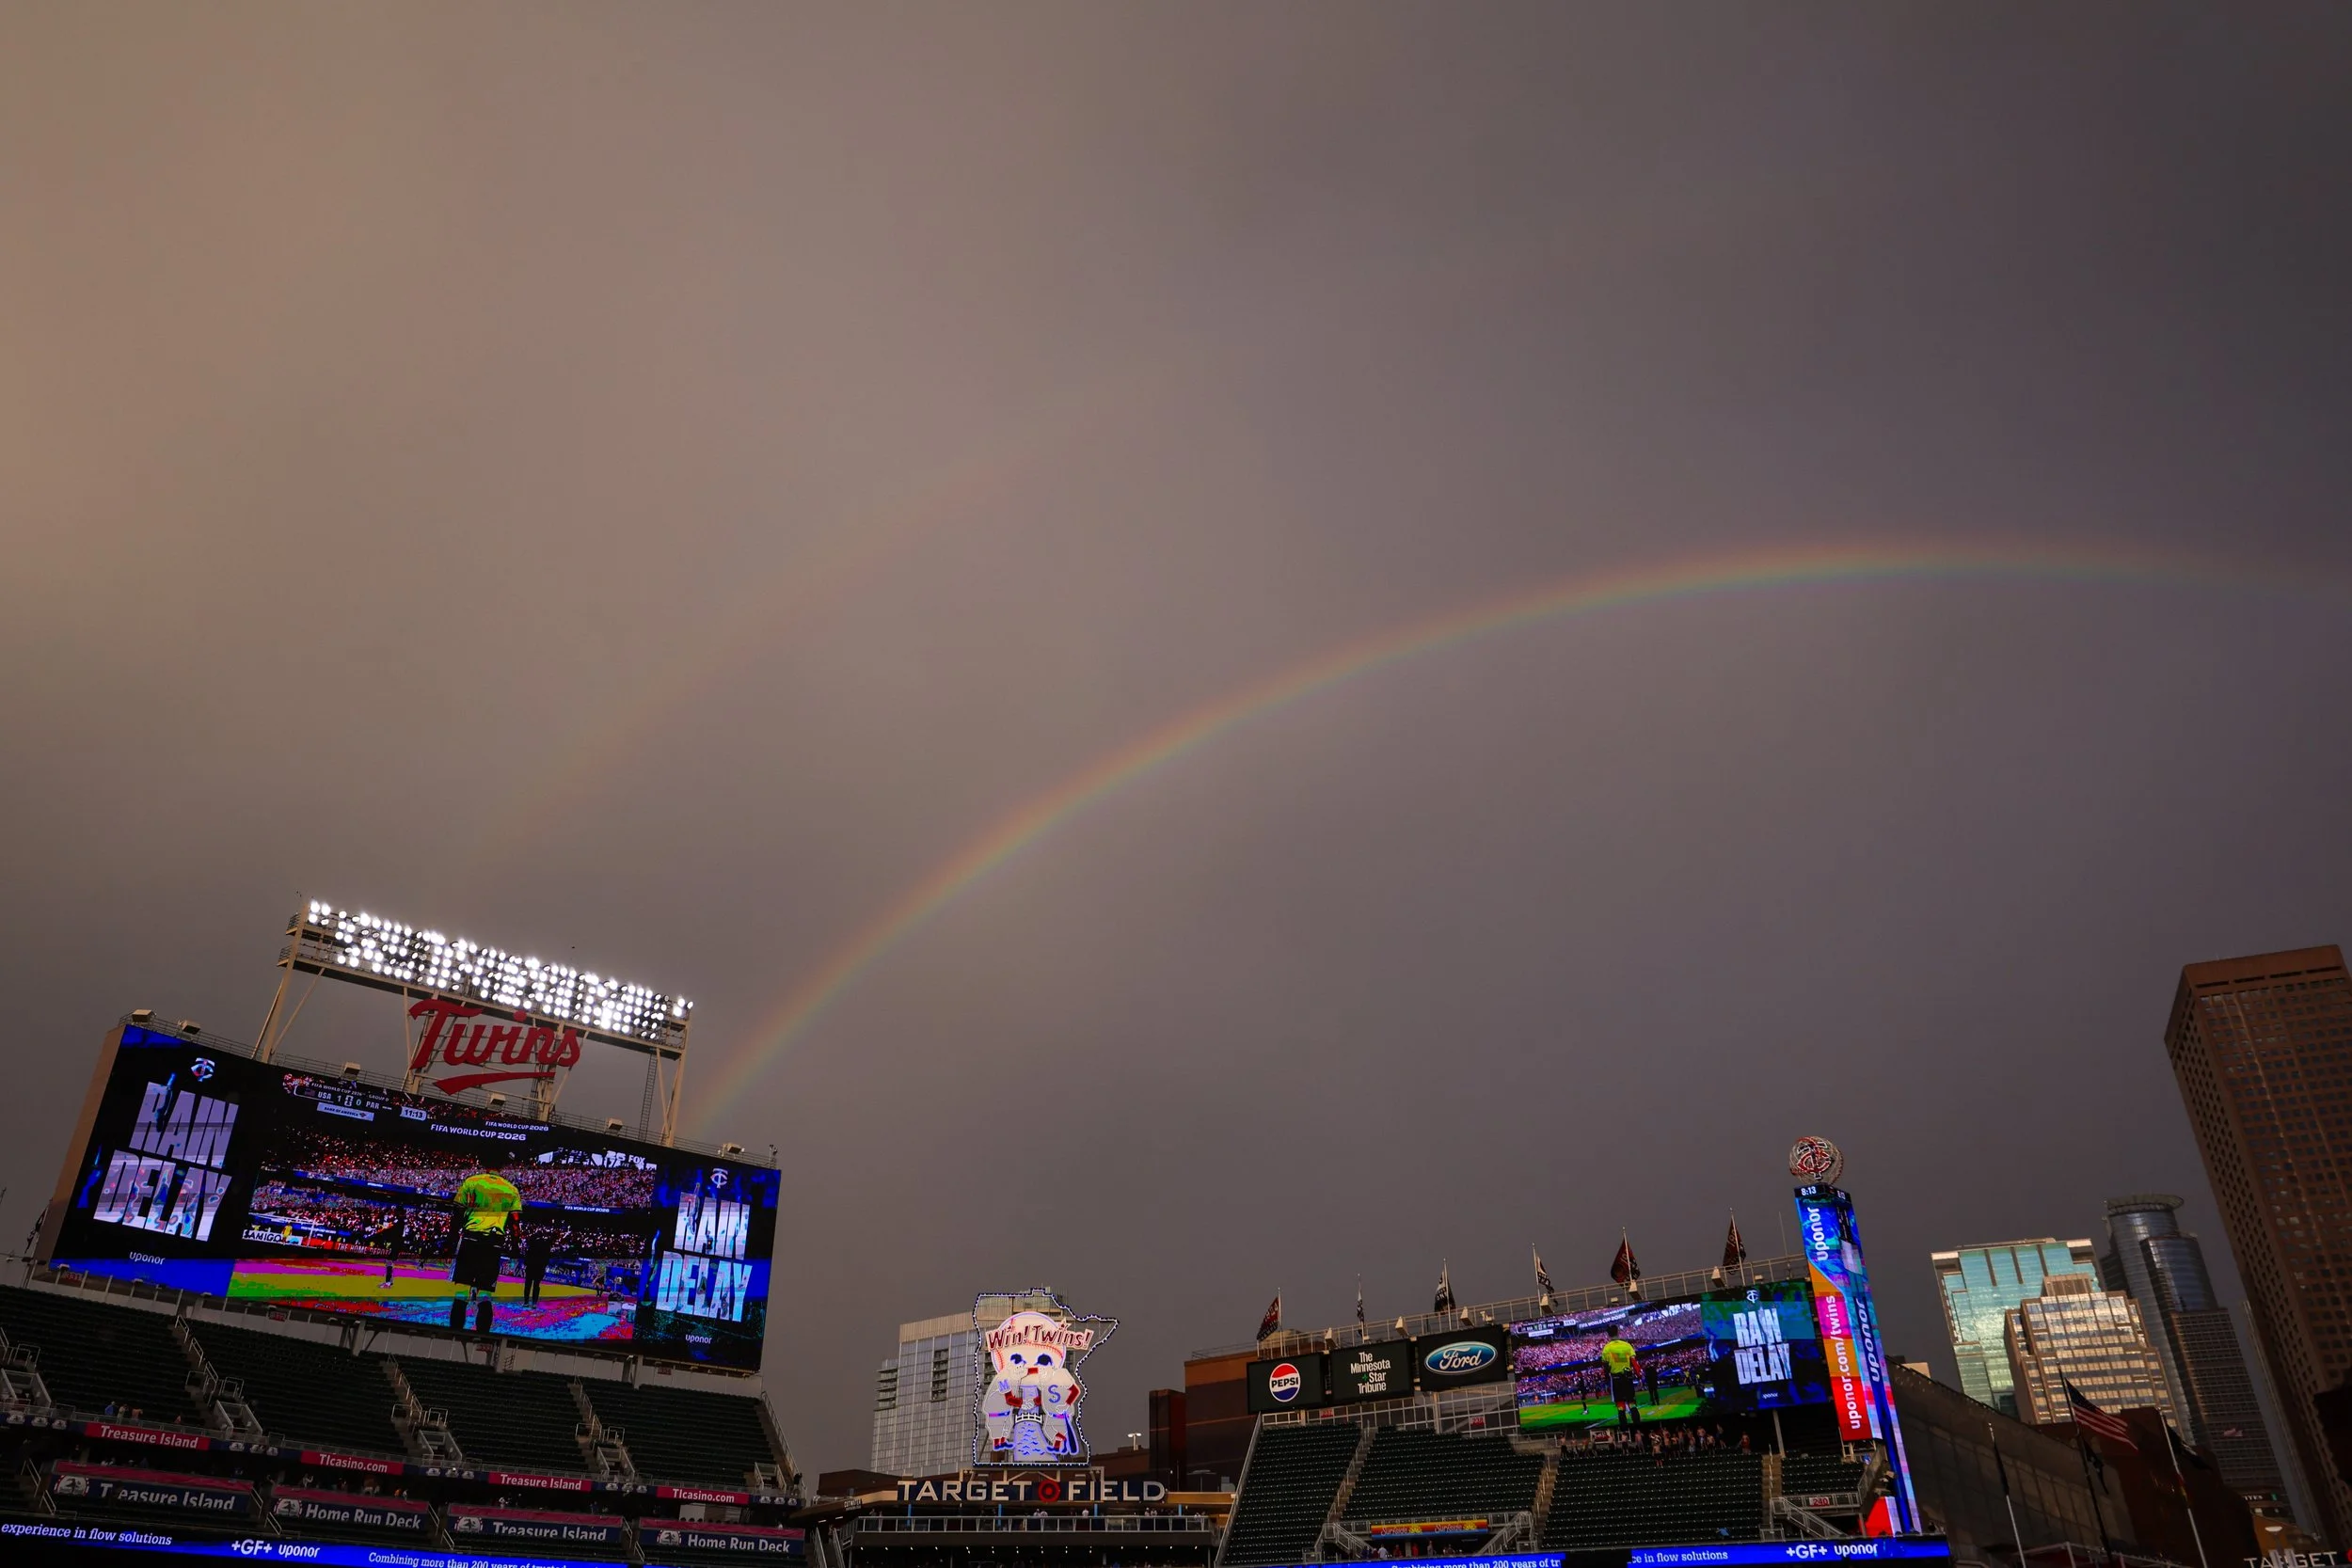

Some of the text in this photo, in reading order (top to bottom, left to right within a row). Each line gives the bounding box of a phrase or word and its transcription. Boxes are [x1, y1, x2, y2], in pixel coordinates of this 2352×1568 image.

[409, 999, 580, 1069] Twins
[318, 1091, 331, 1100] USA
[366, 1101, 380, 1109] PAR
[404, 1109, 423, 1118] 11:13
[129, 1082, 239, 1169] RAIN
[430, 1124, 526, 1141] FIFA WORLD CUP 2026
[628, 1154, 645, 1164] FOX
[93, 1149, 231, 1242] DELAY
[1801, 1186, 1817, 1196] 8:13
[674, 1192, 750, 1259] RAIN
[1807, 1207, 1830, 1261] uponor
[350, 1244, 368, 1254] HOME
[129, 1252, 165, 1265] uponor
[656, 1250, 753, 1323] DELAY
[685, 1334, 712, 1344] uponor
[988, 1323, 1090, 1350] Win! Twins!
[1855, 1298, 1880, 1382] uponor
[1350, 1359, 1391, 1374] Minnesota
[1359, 1353, 1373, 1362] The
[1439, 1347, 1482, 1370] Ford
[1734, 1342, 1792, 1385] DELAY
[1826, 1295, 1862, 1429] uponor.com/twins
[998, 1379, 1010, 1391] M
[1271, 1377, 1299, 1388] PEPSI
[1369, 1370, 1387, 1383] Star
[1048, 1385, 1060, 1403] S
[1358, 1382, 1387, 1394] Tribune
[100, 1425, 199, 1449] Treasure Island
[500, 1474, 581, 1491] Treasure Island
[898, 1481, 1166, 1501] TARGET FIELD
[101, 1482, 235, 1511] Teasure Island
[305, 1504, 421, 1529] Home Run Deck
[1, 1523, 172, 1545] experience in flow solutions
[493, 1521, 607, 1541] Treasure Island
[278, 1544, 320, 1559] uponor
[688, 1534, 790, 1553] Home Run Deck
[1834, 1544, 1878, 1557] uponor
[369, 1552, 420, 1568] Combining
[421, 1559, 444, 1568] more
[447, 1559, 469, 1568] than
[1539, 1559, 1549, 1567] of
[1644, 1553, 1654, 1563] in
[1657, 1552, 1678, 1562] flow
[1681, 1550, 1728, 1561] solutions
